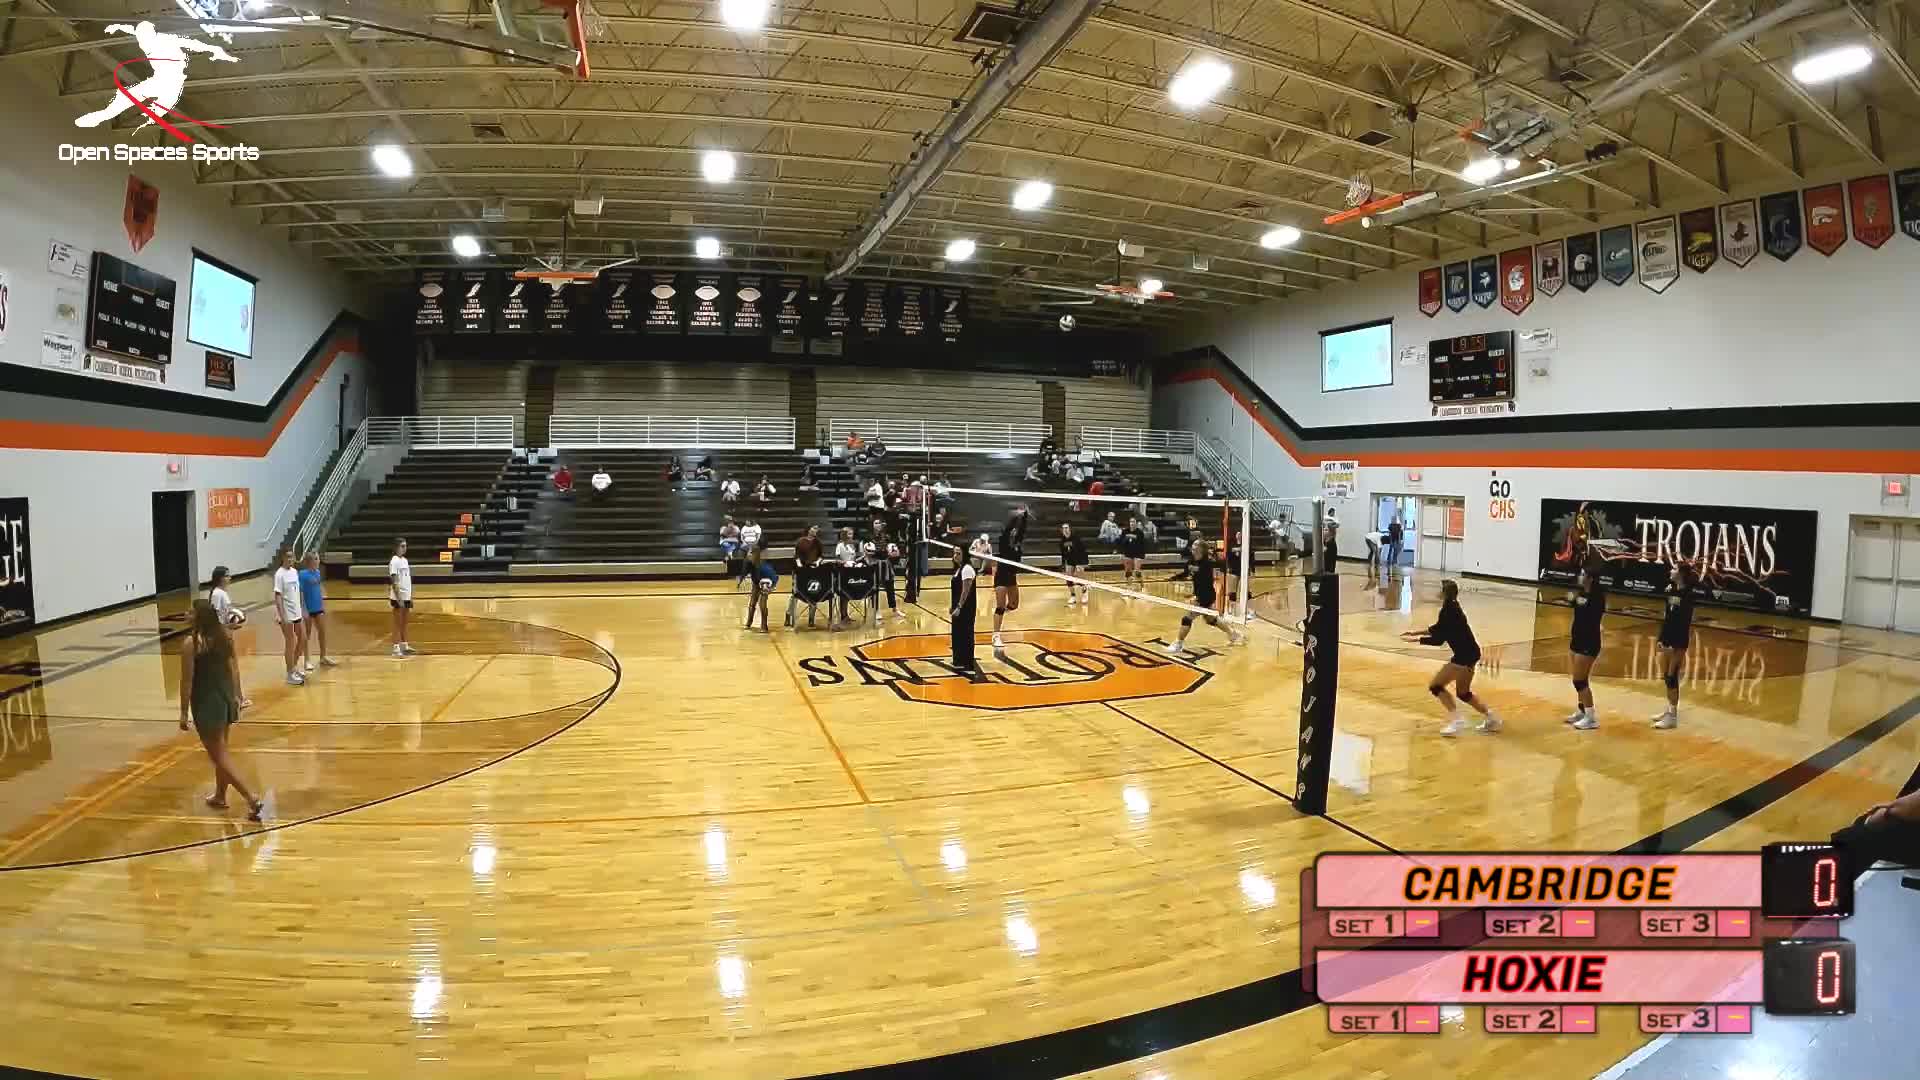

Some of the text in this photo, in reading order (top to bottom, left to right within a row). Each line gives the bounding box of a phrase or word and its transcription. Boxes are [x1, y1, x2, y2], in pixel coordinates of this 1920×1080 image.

[1490, 480, 1511, 498] GO
[1490, 499, 1516, 519] CHS
[1636, 514, 1778, 582] TROJANS
[1298, 604, 1322, 801] TROJANS
[1814, 858, 1836, 906] 0
[1817, 951, 1840, 1003] 0
